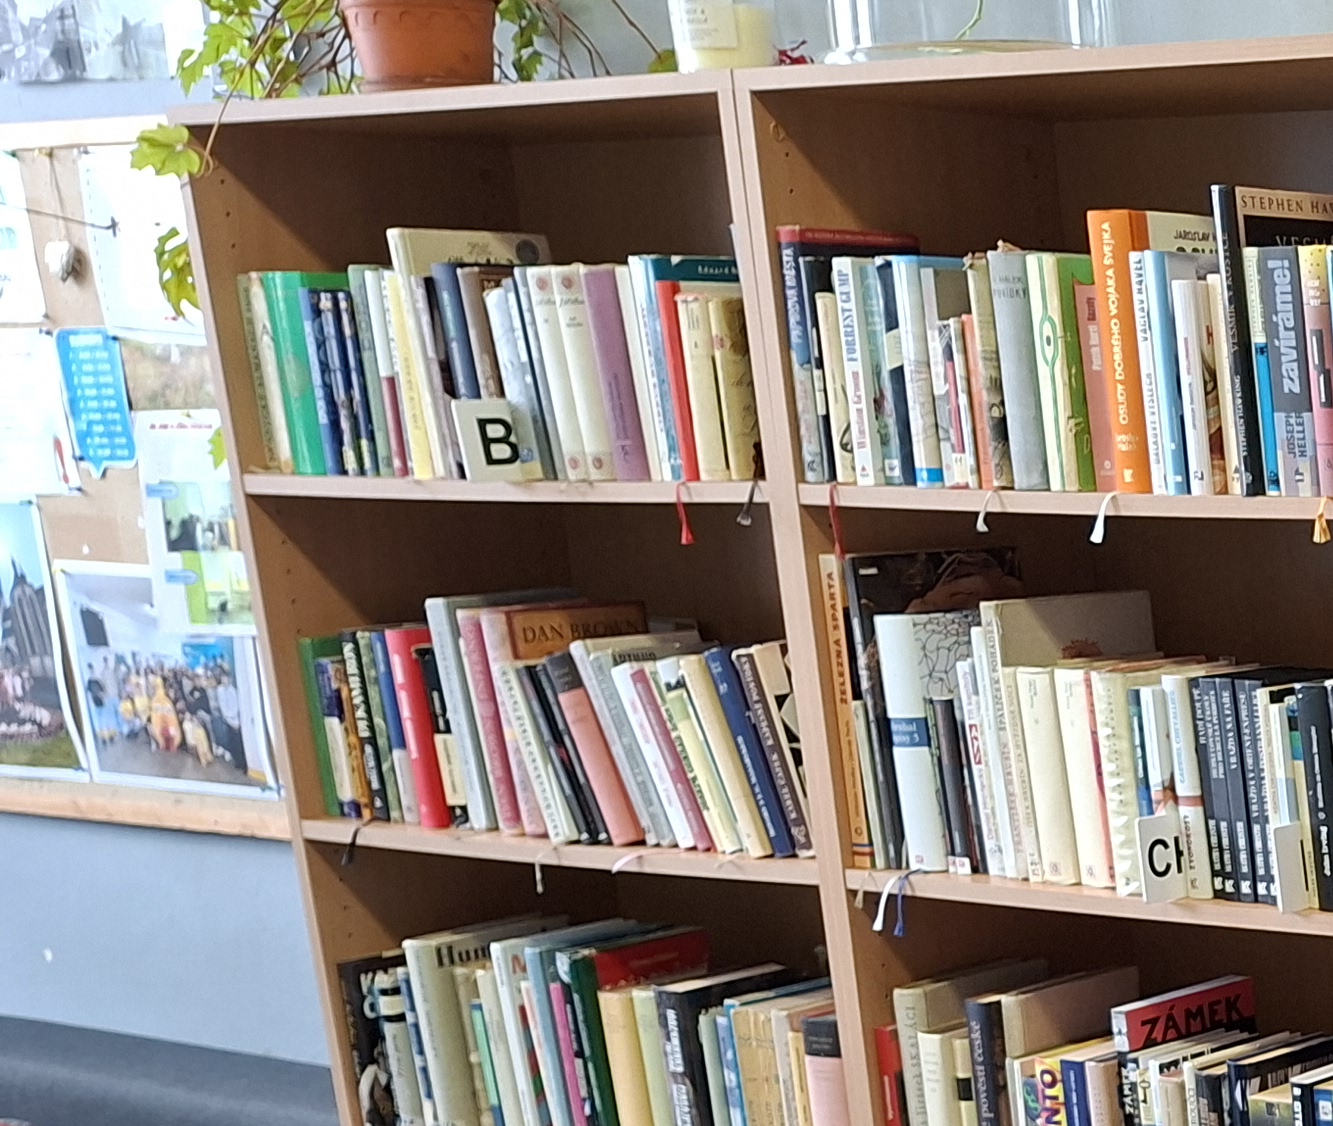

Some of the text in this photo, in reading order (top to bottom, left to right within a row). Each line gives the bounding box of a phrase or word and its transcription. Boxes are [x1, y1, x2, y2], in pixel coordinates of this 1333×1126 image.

[1241, 194, 1303, 212] STEPHEN
[1267, 259, 1300, 394] zavíráme!
[1118, 384, 1129, 425] OSUDY
[477, 418, 520, 465] B
[1285, 412, 1296, 458] JOSEPH
[1294, 412, 1306, 458] HELLER
[827, 572, 841, 631] SPARTA
[522, 626, 562, 644] DAN
[1140, 993, 1250, 1048] ZÁMEK
